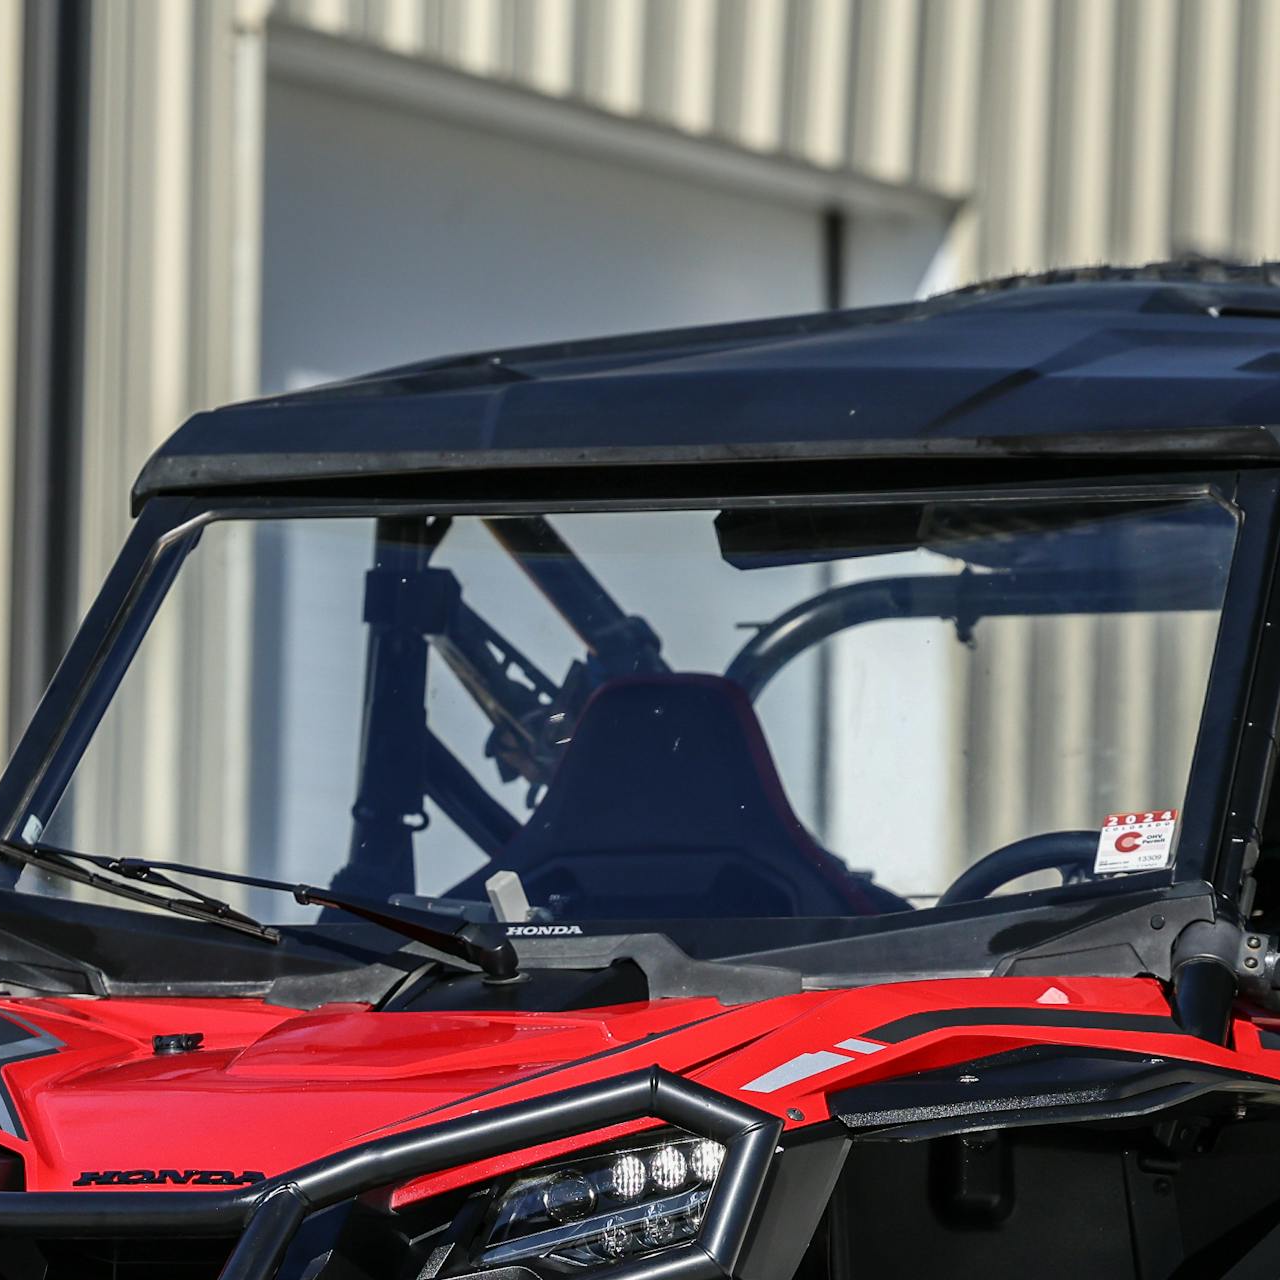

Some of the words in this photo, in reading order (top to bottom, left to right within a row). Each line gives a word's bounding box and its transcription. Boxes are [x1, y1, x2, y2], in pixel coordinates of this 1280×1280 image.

[1107, 811, 1172, 826] 2024
[506, 926, 583, 936] HONDA
[73, 1170, 266, 1186] HONDA
